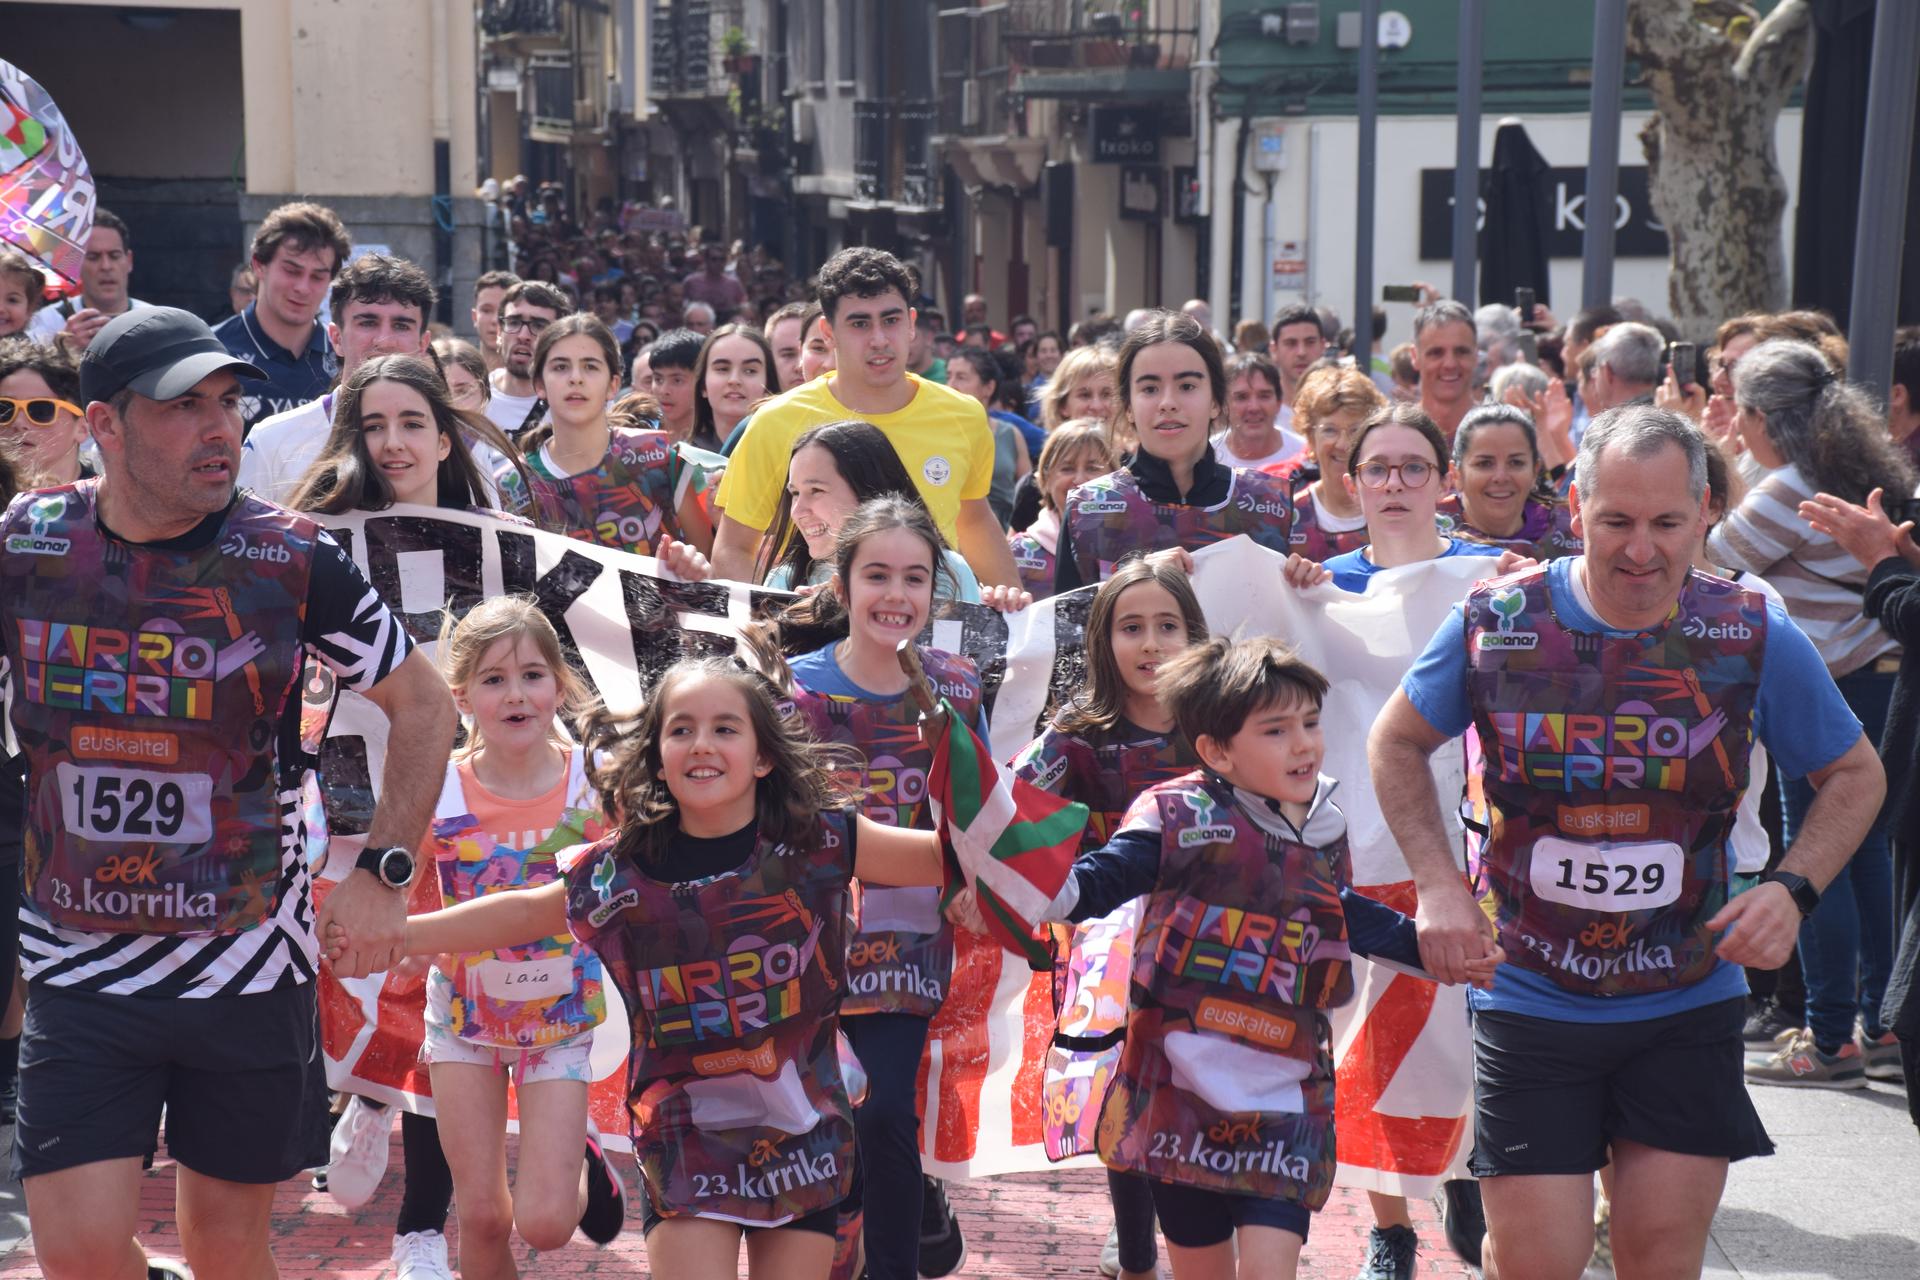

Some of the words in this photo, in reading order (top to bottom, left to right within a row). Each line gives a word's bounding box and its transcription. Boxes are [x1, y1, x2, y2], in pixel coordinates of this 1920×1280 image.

[638, 451, 665, 463] eitb
[1255, 500, 1286, 519] eitb
[246, 541, 291, 564] eitb
[16, 618, 217, 681] HARRO
[1707, 621, 1753, 640] eitb
[22, 659, 214, 720] HERRI
[939, 681, 974, 700] eitb
[78, 734, 170, 758] euskaltel
[1488, 712, 1688, 757] HARRO
[1499, 745, 1687, 792] HERRI
[73, 775, 185, 837] 1529
[1563, 809, 1641, 830] euskaltel
[95, 844, 162, 885] aek
[1555, 858, 1666, 897] 1529
[51, 877, 218, 919] 23.korrika
[849, 931, 901, 968] aek
[1579, 912, 1635, 949] aek
[655, 978, 801, 1049] ERRI
[1203, 1006, 1288, 1042] euskaltel
[1148, 1131, 1311, 1184] 23.korrika
